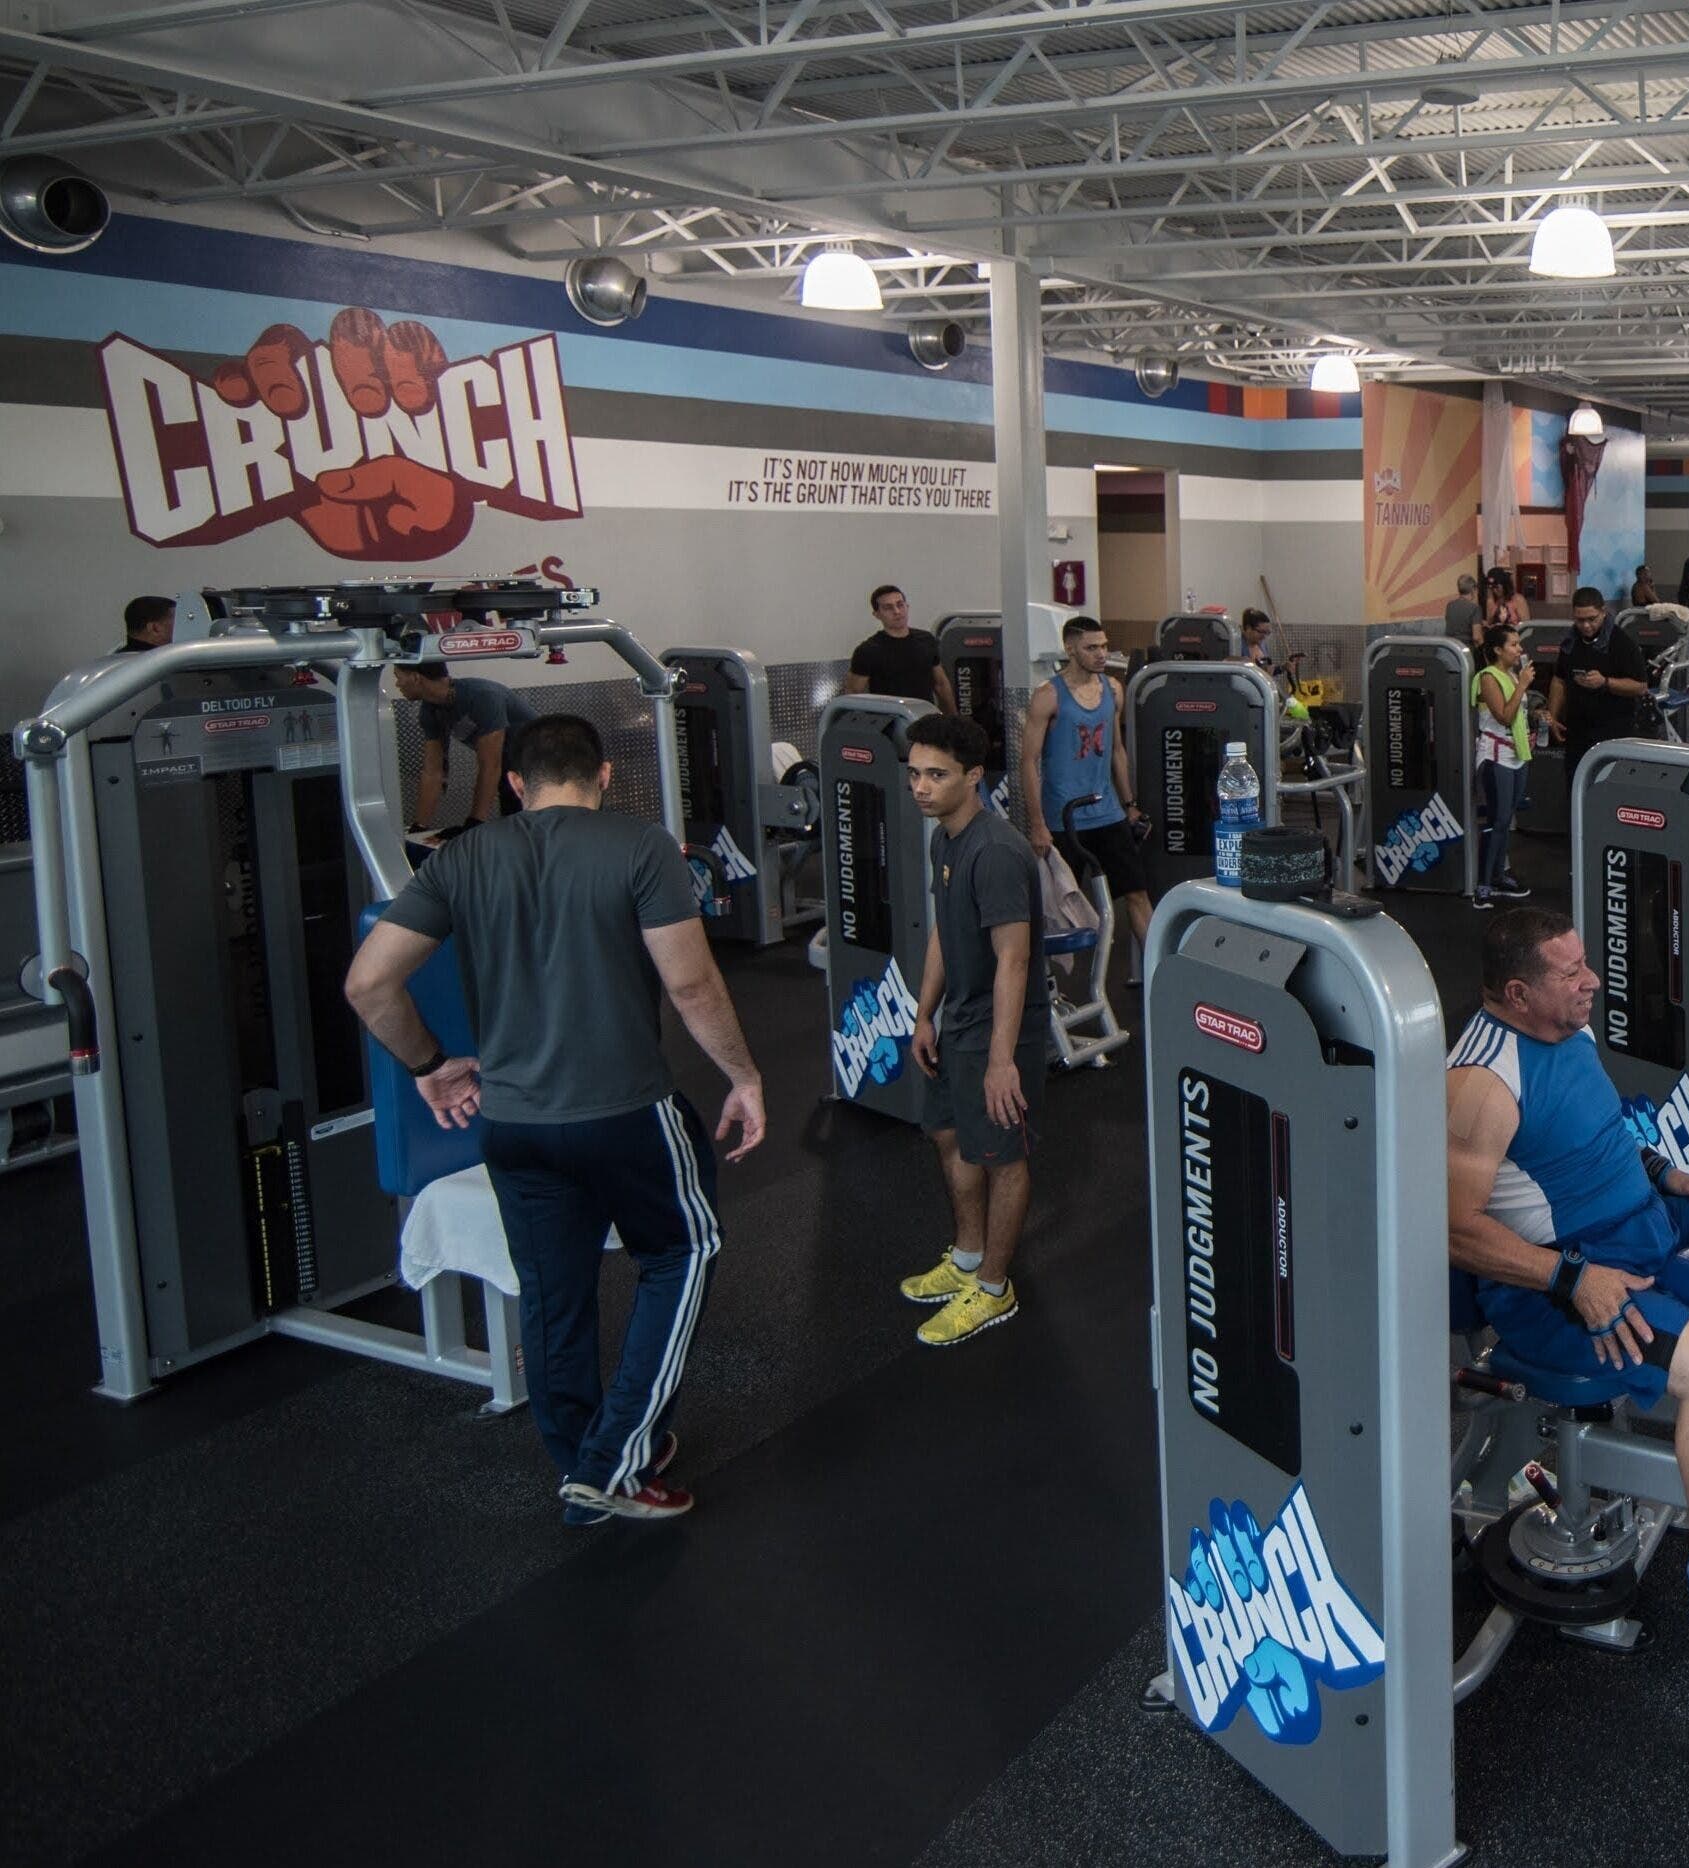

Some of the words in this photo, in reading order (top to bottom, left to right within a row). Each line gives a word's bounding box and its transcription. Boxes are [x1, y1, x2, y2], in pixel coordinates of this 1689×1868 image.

[101, 333, 580, 542] CRUNCH
[763, 458, 793, 479] IT'S
[797, 460, 827, 481] NOT
[830, 461, 865, 482] HOW
[868, 463, 907, 485] MUCH
[911, 465, 938, 486] YOU
[940, 467, 967, 486] LIFT
[728, 480, 759, 502] IT'S
[764, 481, 791, 503] THE
[796, 483, 848, 504] GRUNT
[850, 486, 884, 505] THAT
[888, 487, 922, 507] GETS
[925, 488, 951, 507] YOU
[954, 489, 992, 509] THERE
[1376, 502, 1432, 526] TANNING
[446, 639, 480, 649] STAR
[481, 637, 515, 647] TRAC
[202, 698, 250, 713] DELTOID
[255, 696, 276, 708] FLY
[958, 666, 972, 716] GMENTS
[1388, 689, 1404, 763] JUDGMENTS
[141, 764, 195, 776] IMPACT
[1165, 729, 1184, 823] JUDGMENTS
[1391, 767, 1404, 787] NO
[1374, 792, 1464, 885] CRUNCH
[1620, 811, 1639, 821] STAR
[1640, 814, 1661, 824] TRAC
[837, 782, 856, 903] JUDGMENTS
[1167, 828, 1185, 852] NO
[843, 911, 857, 939] NO
[1604, 849, 1628, 1002] JUDGMENTS
[833, 955, 920, 1099] CRUNCH
[1198, 1012, 1226, 1031] STAR
[1227, 1023, 1257, 1042] TRAC
[1608, 1010, 1629, 1047] NO
[1182, 1076, 1215, 1338] JUDGMENTS
[1276, 1196, 1288, 1278] ADDUCTOR
[1193, 1348, 1220, 1414] NO
[1169, 1483, 1386, 1729] CRUNCH
